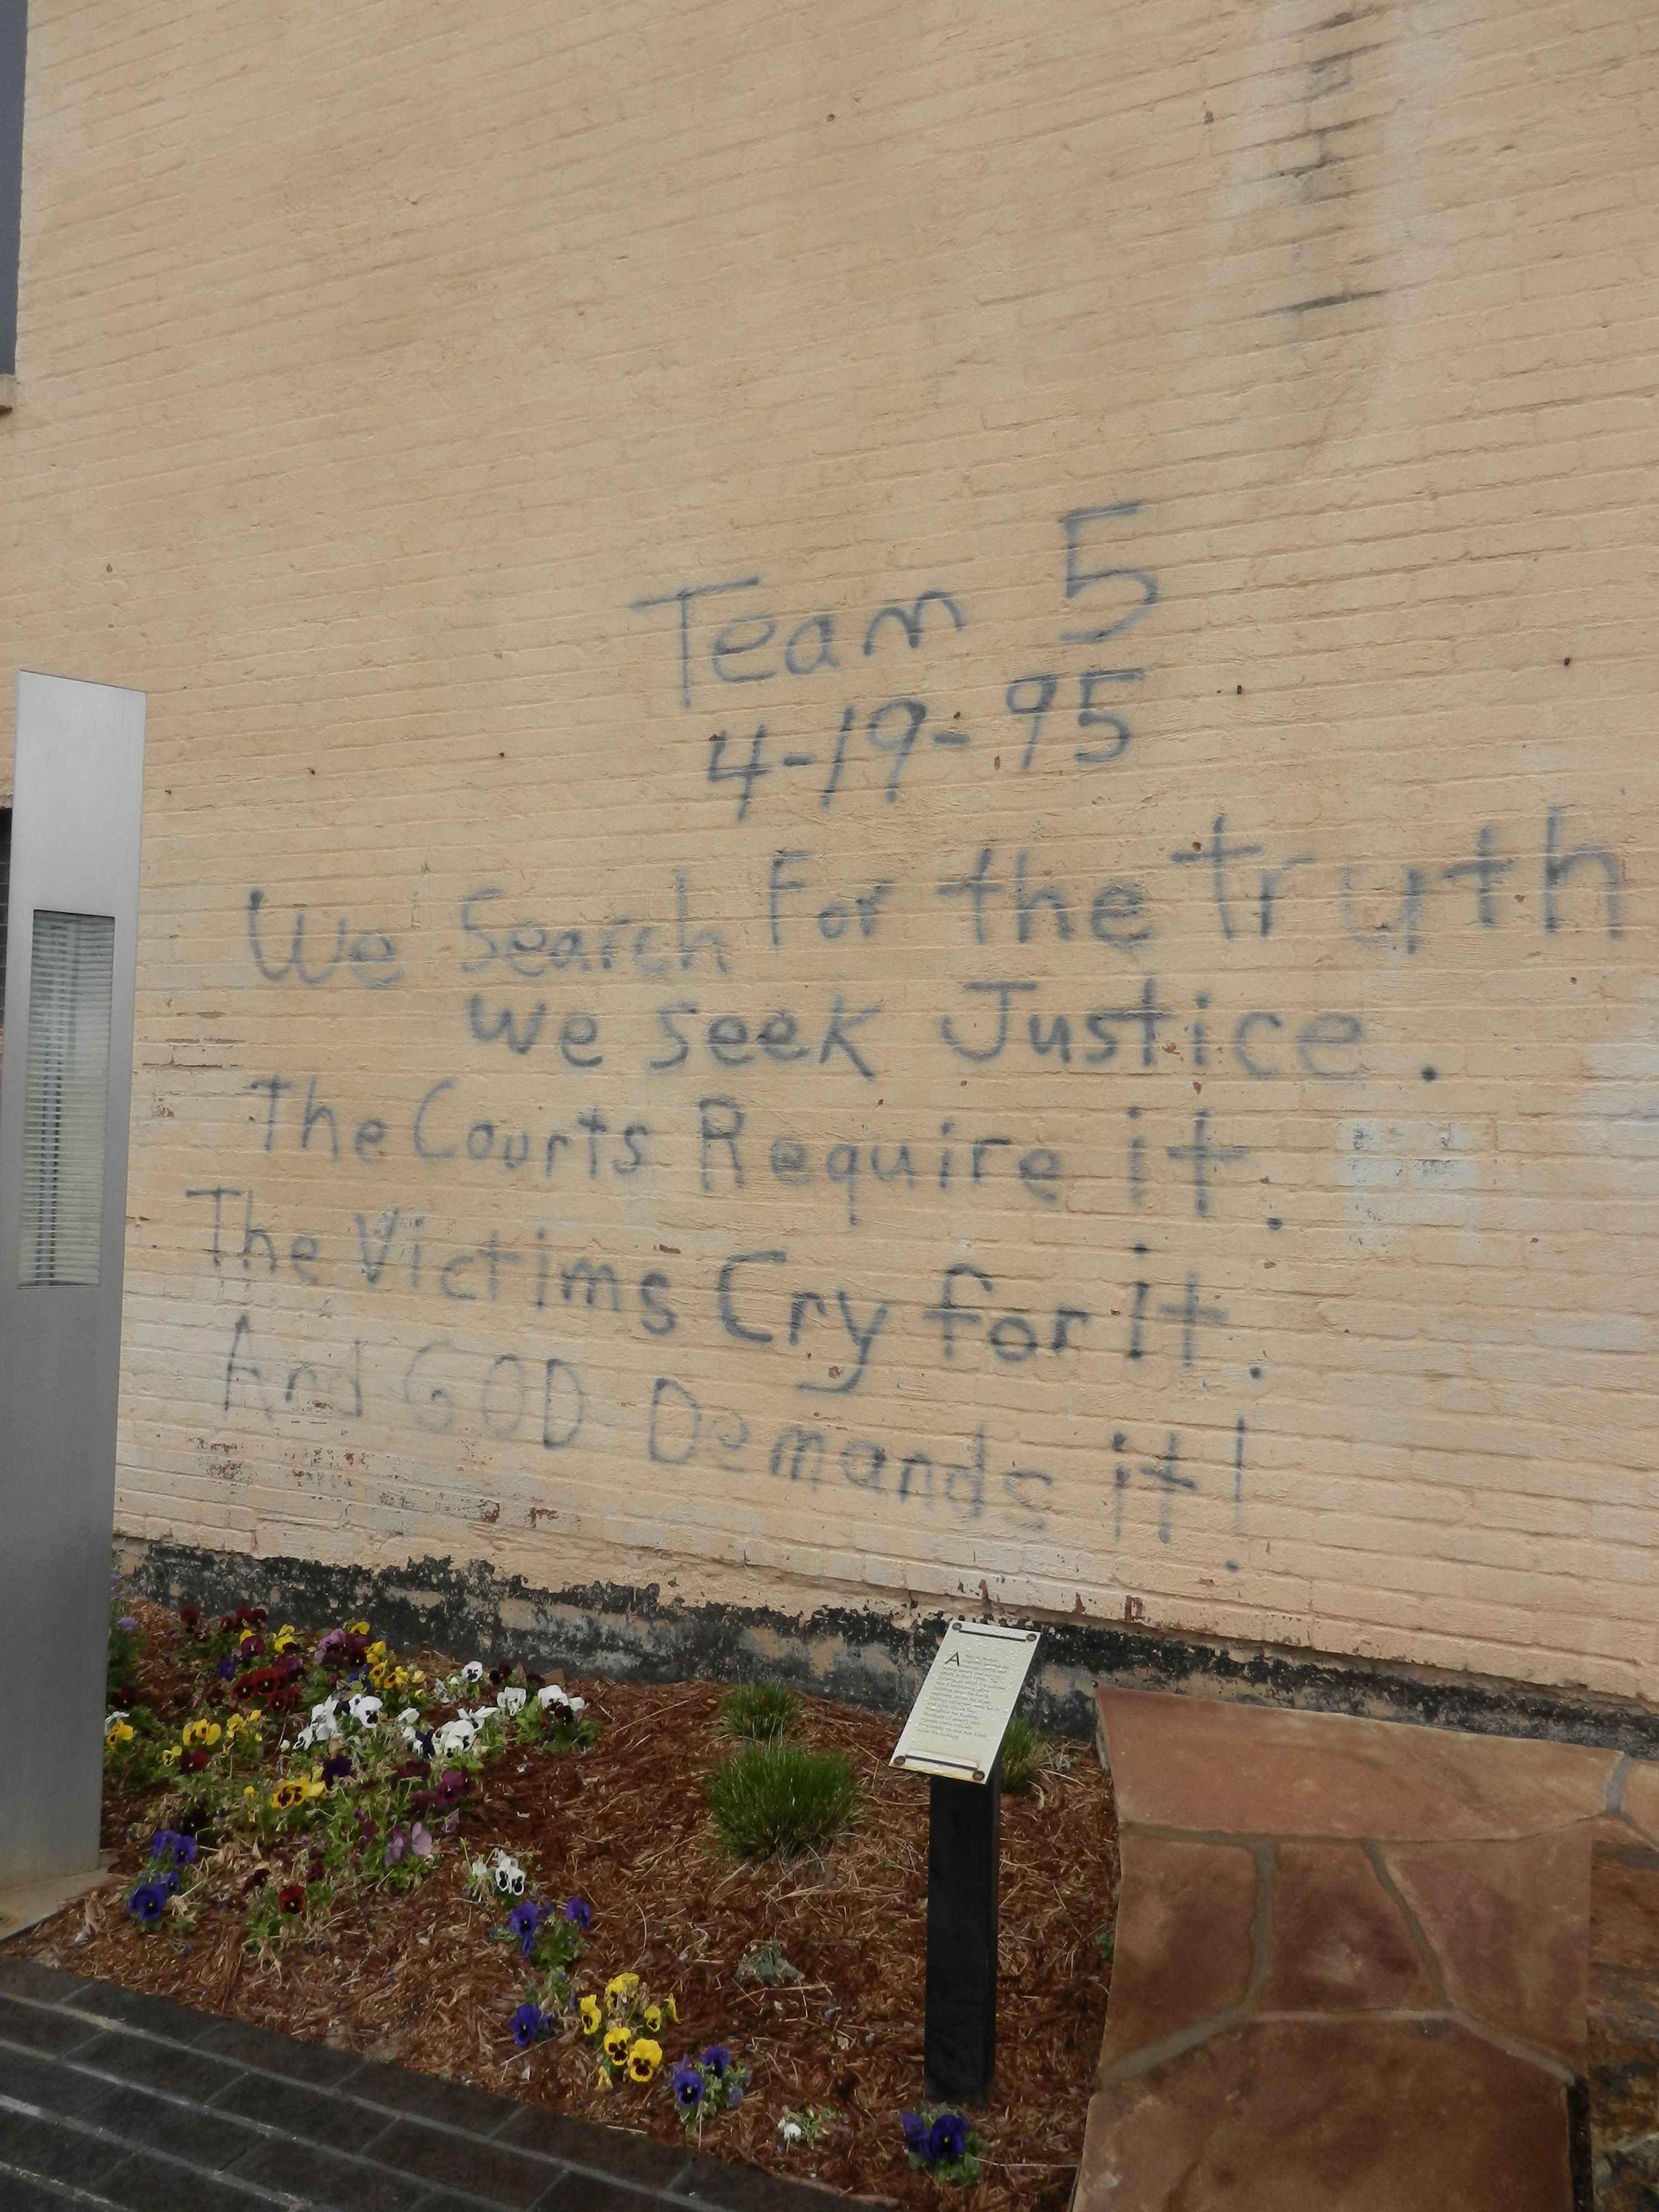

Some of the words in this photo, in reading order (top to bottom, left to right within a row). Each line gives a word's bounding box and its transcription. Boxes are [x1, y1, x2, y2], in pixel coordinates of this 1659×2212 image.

[629, 575, 966, 709] Team
[1061, 501, 1159, 644] 5
[459, 869, 729, 979] Search
[769, 849, 891, 947] For
[938, 848, 1151, 949] the
[1168, 806, 1626, 956] truth
[247, 1074, 387, 1164] The
[413, 1078, 650, 1181] Courts
[697, 1097, 1062, 1225] Require
[186, 1186, 321, 1286] The
[352, 1207, 678, 1336] Victims
[716, 1249, 888, 1394] Cry
[924, 1263, 1091, 1361] for
[222, 1314, 365, 1420] And
[647, 1377, 1054, 1533] Demands
[945, 1652, 959, 1666] A
